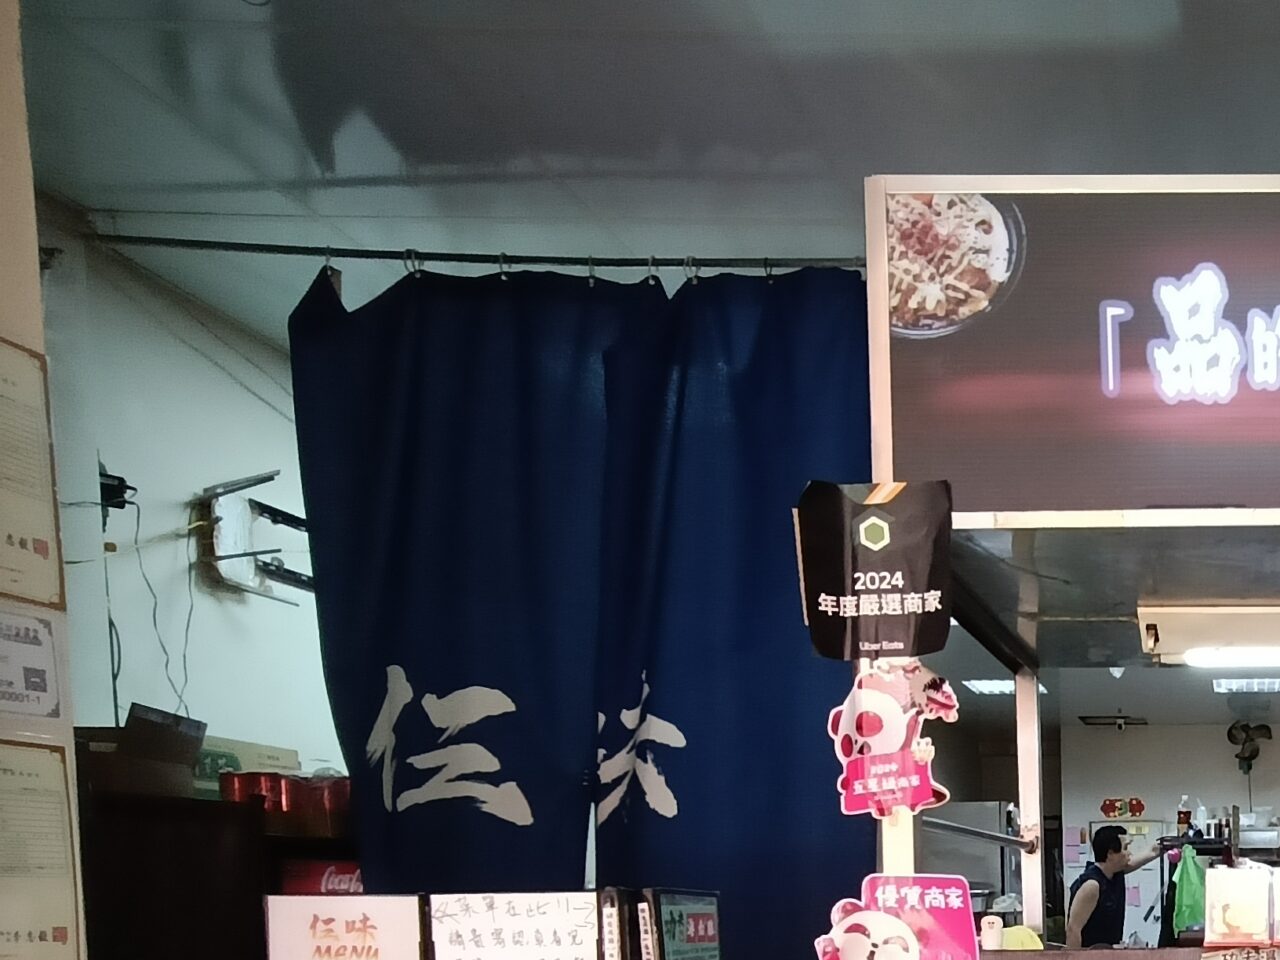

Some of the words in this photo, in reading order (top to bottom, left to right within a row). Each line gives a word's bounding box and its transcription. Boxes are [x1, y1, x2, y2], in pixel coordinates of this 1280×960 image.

[854, 571, 904, 590] 2024
[859, 641, 881, 650] Uber
[882, 641, 904, 650] Eats
[875, 885, 964, 909] 優質商家
[312, 945, 379, 960] MENU
